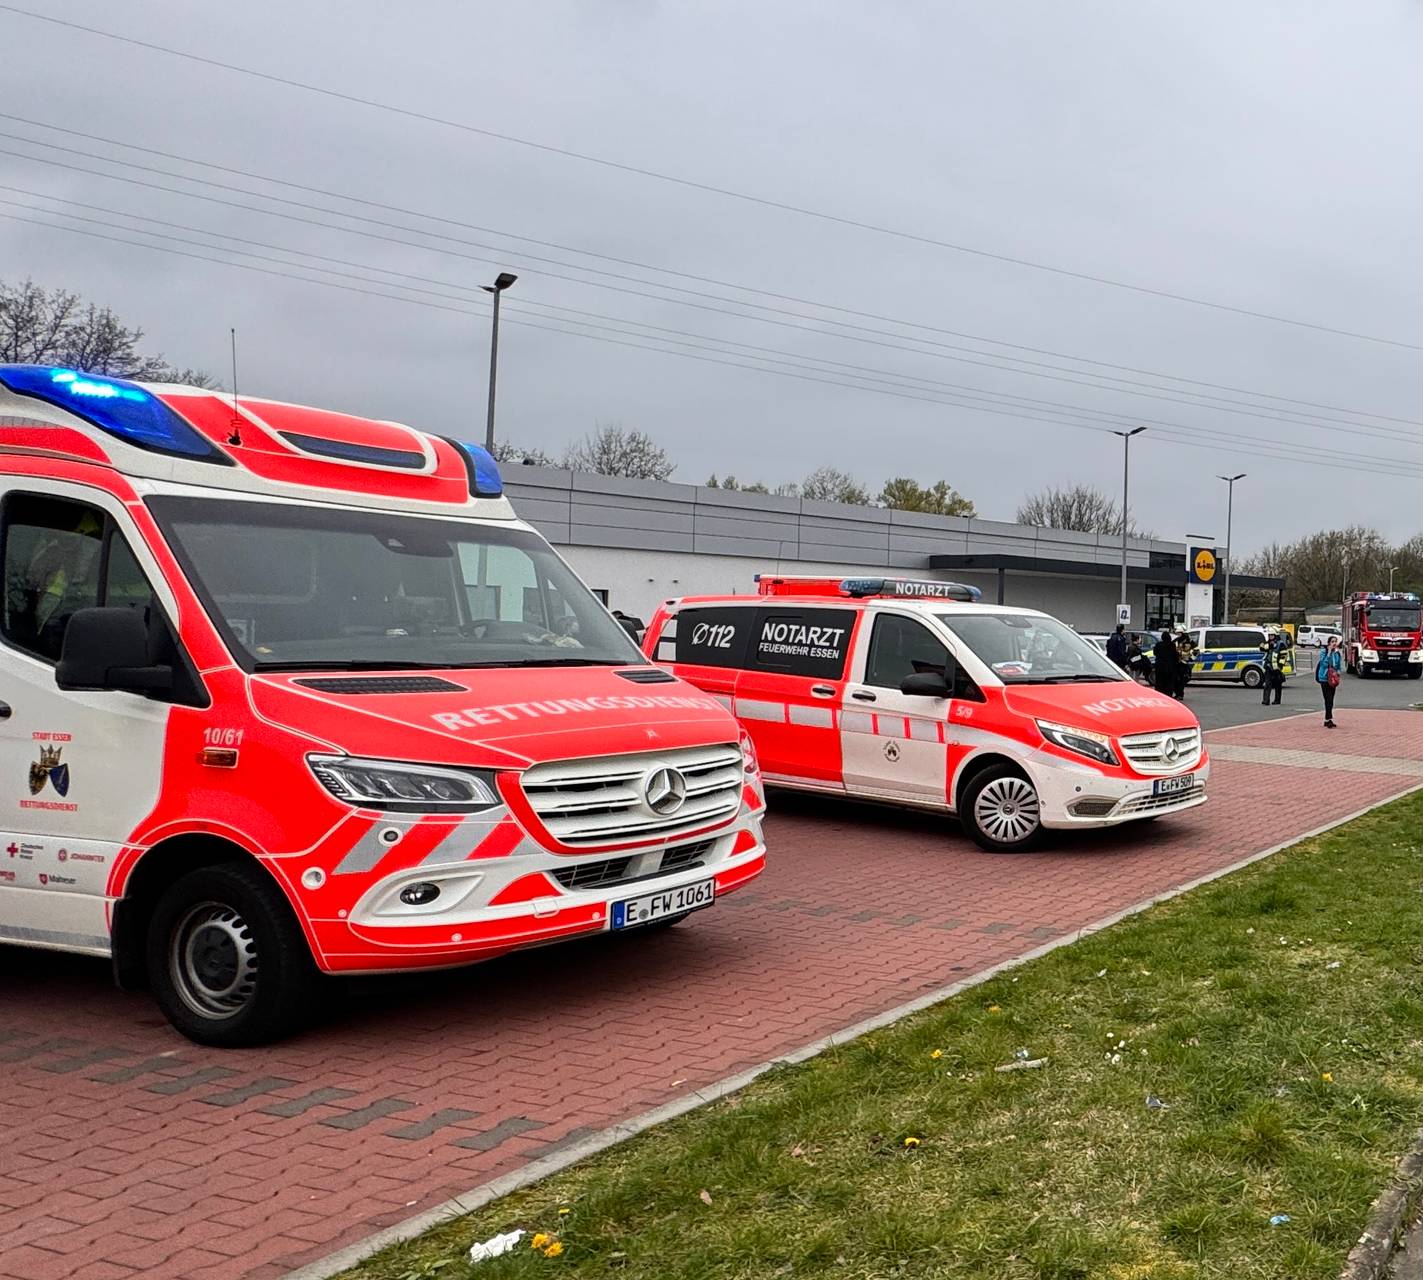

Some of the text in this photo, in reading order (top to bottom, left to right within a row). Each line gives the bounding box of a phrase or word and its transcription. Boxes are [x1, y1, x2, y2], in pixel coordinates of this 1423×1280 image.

[895, 582, 950, 597] NOTARZT
[707, 622, 844, 648] 112 NOTARZT
[758, 642, 839, 659] FEUERWEHR ESSEN
[431, 696, 723, 731] RETTUNGSDIENST
[32, 732, 72, 742] STADT ESSEN
[203, 727, 244, 745] 10/61
[1161, 780, 1166, 791] E
[20, 800, 78, 812] RETTUNGSDIENST
[626, 902, 638, 922] E
[650, 893, 673, 916] FW
[676, 881, 713, 909] 1061
